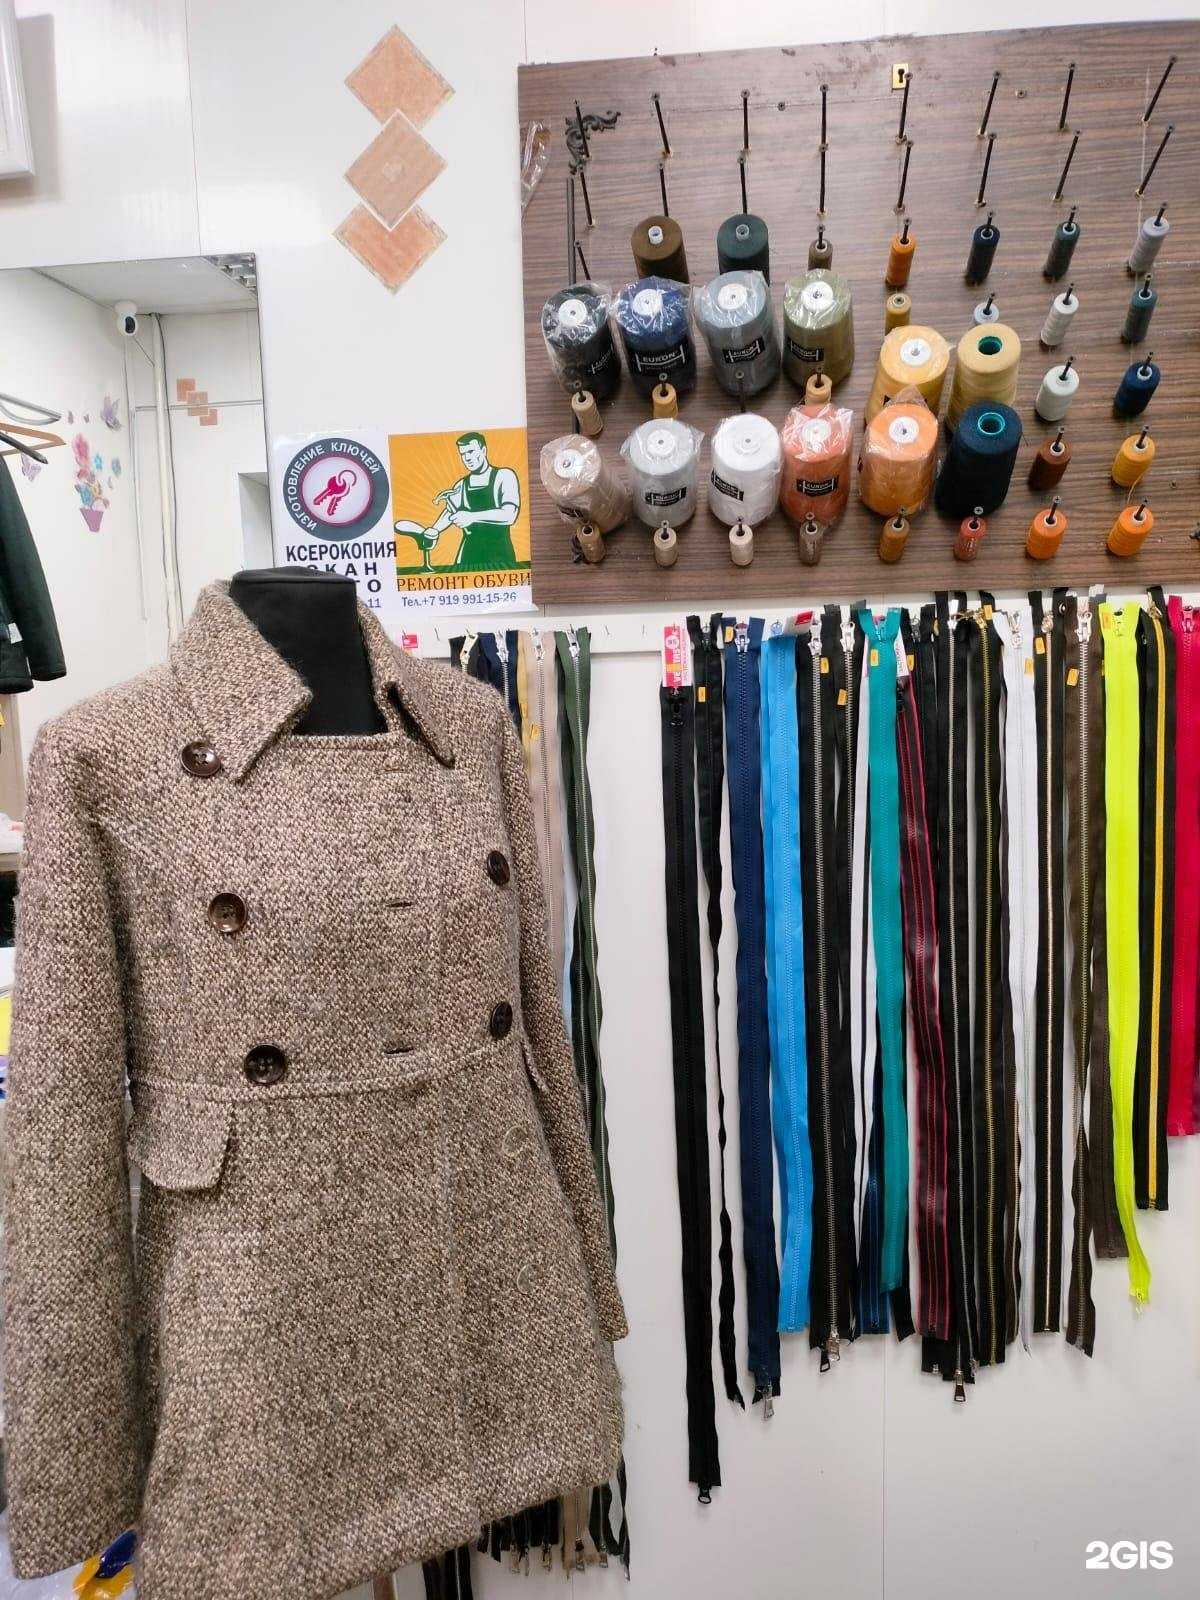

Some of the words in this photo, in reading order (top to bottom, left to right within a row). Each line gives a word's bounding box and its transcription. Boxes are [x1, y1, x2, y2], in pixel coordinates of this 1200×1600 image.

[287, 444, 325, 531] ИЗГОТОВЛЕНИЕ
[331, 441, 380, 474] КЛЮЧЕЙ
[286, 541, 397, 562] КСЕРОКОПИЯ
[396, 575, 468, 592] РЕМОНТ
[473, 572, 532, 588] ОБУВИ
[439, 594, 460, 606] 919
[462, 591, 517, 605] 991-15-26
